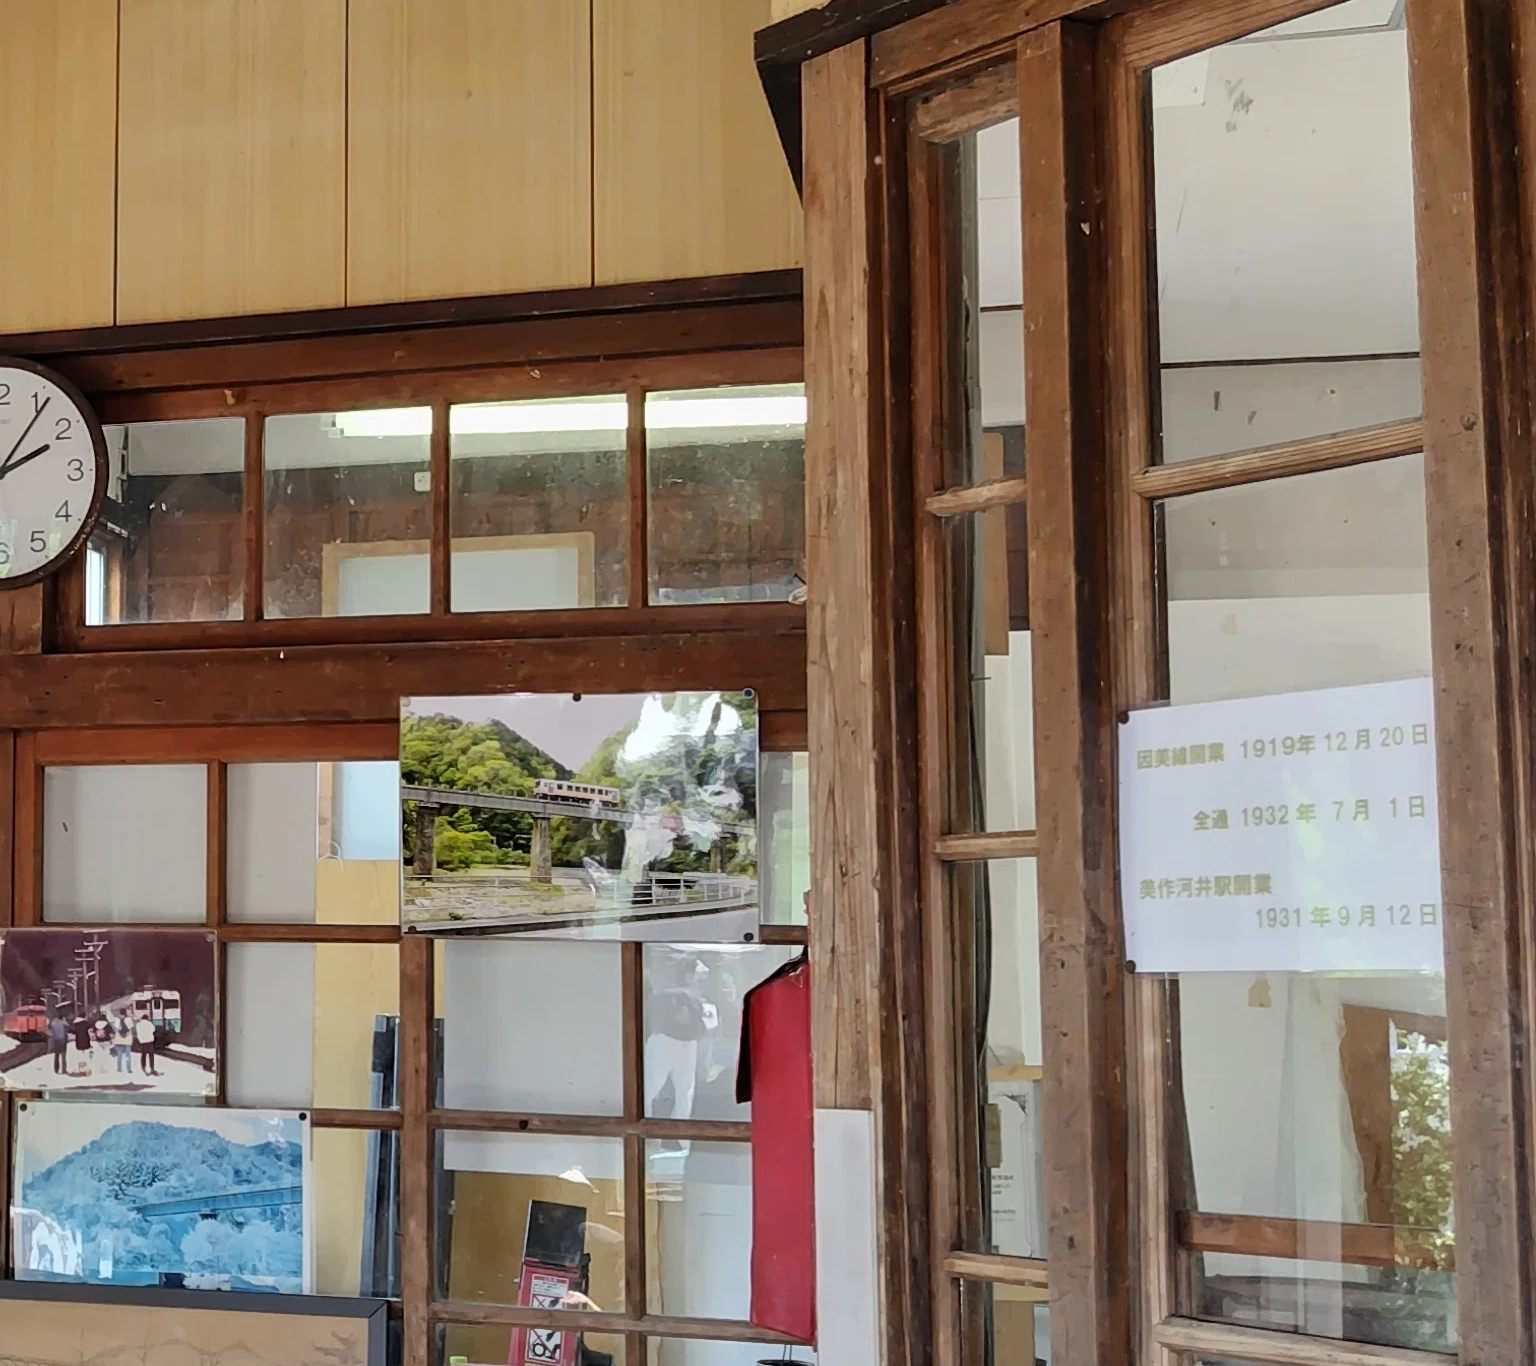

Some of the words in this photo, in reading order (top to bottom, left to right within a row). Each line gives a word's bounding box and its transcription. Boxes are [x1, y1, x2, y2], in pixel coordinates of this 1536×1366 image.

[54, 418, 73, 440] 2
[66, 459, 85, 481] 3
[54, 500, 73, 522] 4
[29, 530, 47, 553] 5
[1136, 742, 1225, 769] 因美線開業
[1193, 809, 1230, 831] 全通
[1140, 873, 1272, 900] 美作河井駅開業
